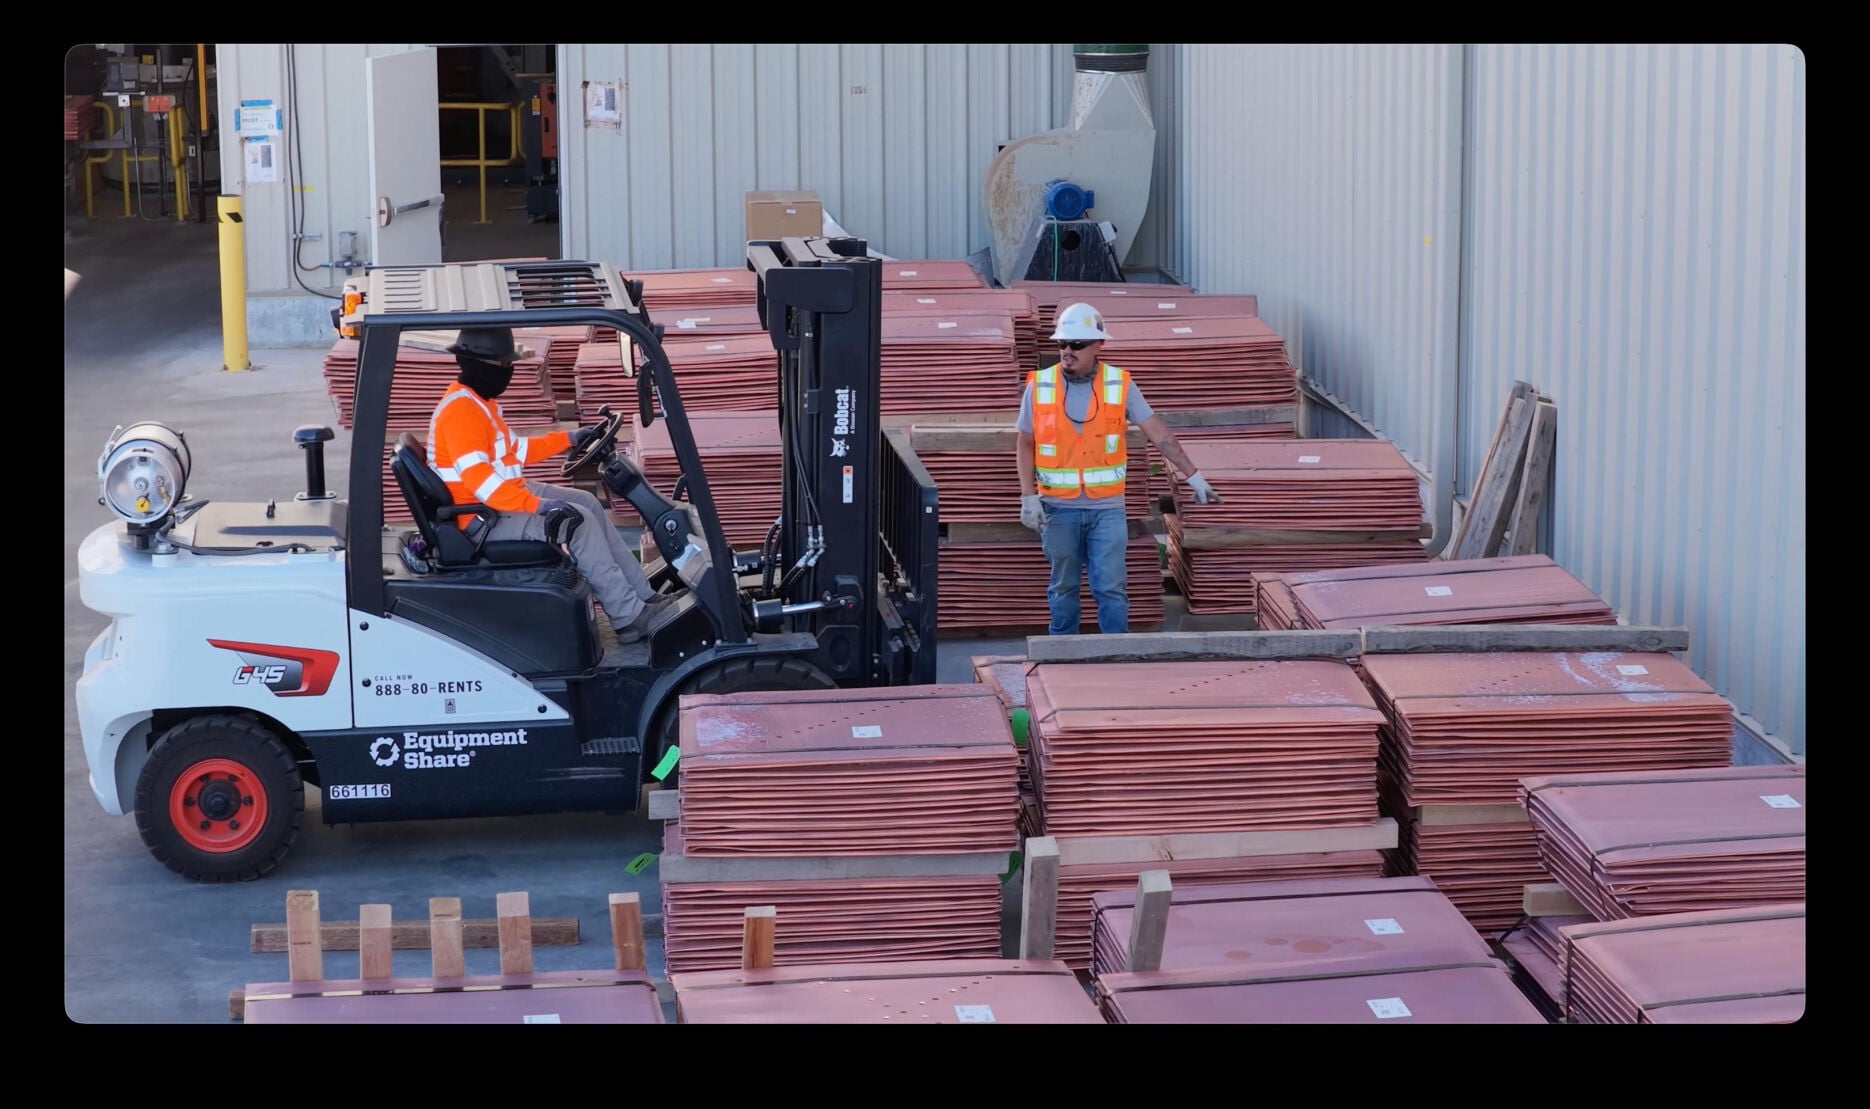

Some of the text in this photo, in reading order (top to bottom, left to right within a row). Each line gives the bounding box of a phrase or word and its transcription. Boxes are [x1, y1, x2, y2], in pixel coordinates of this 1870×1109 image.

[834, 388, 850, 435] Bobcat
[232, 665, 287, 685] G45
[403, 729, 528, 752] Equipment
[331, 784, 390, 798] 661116
